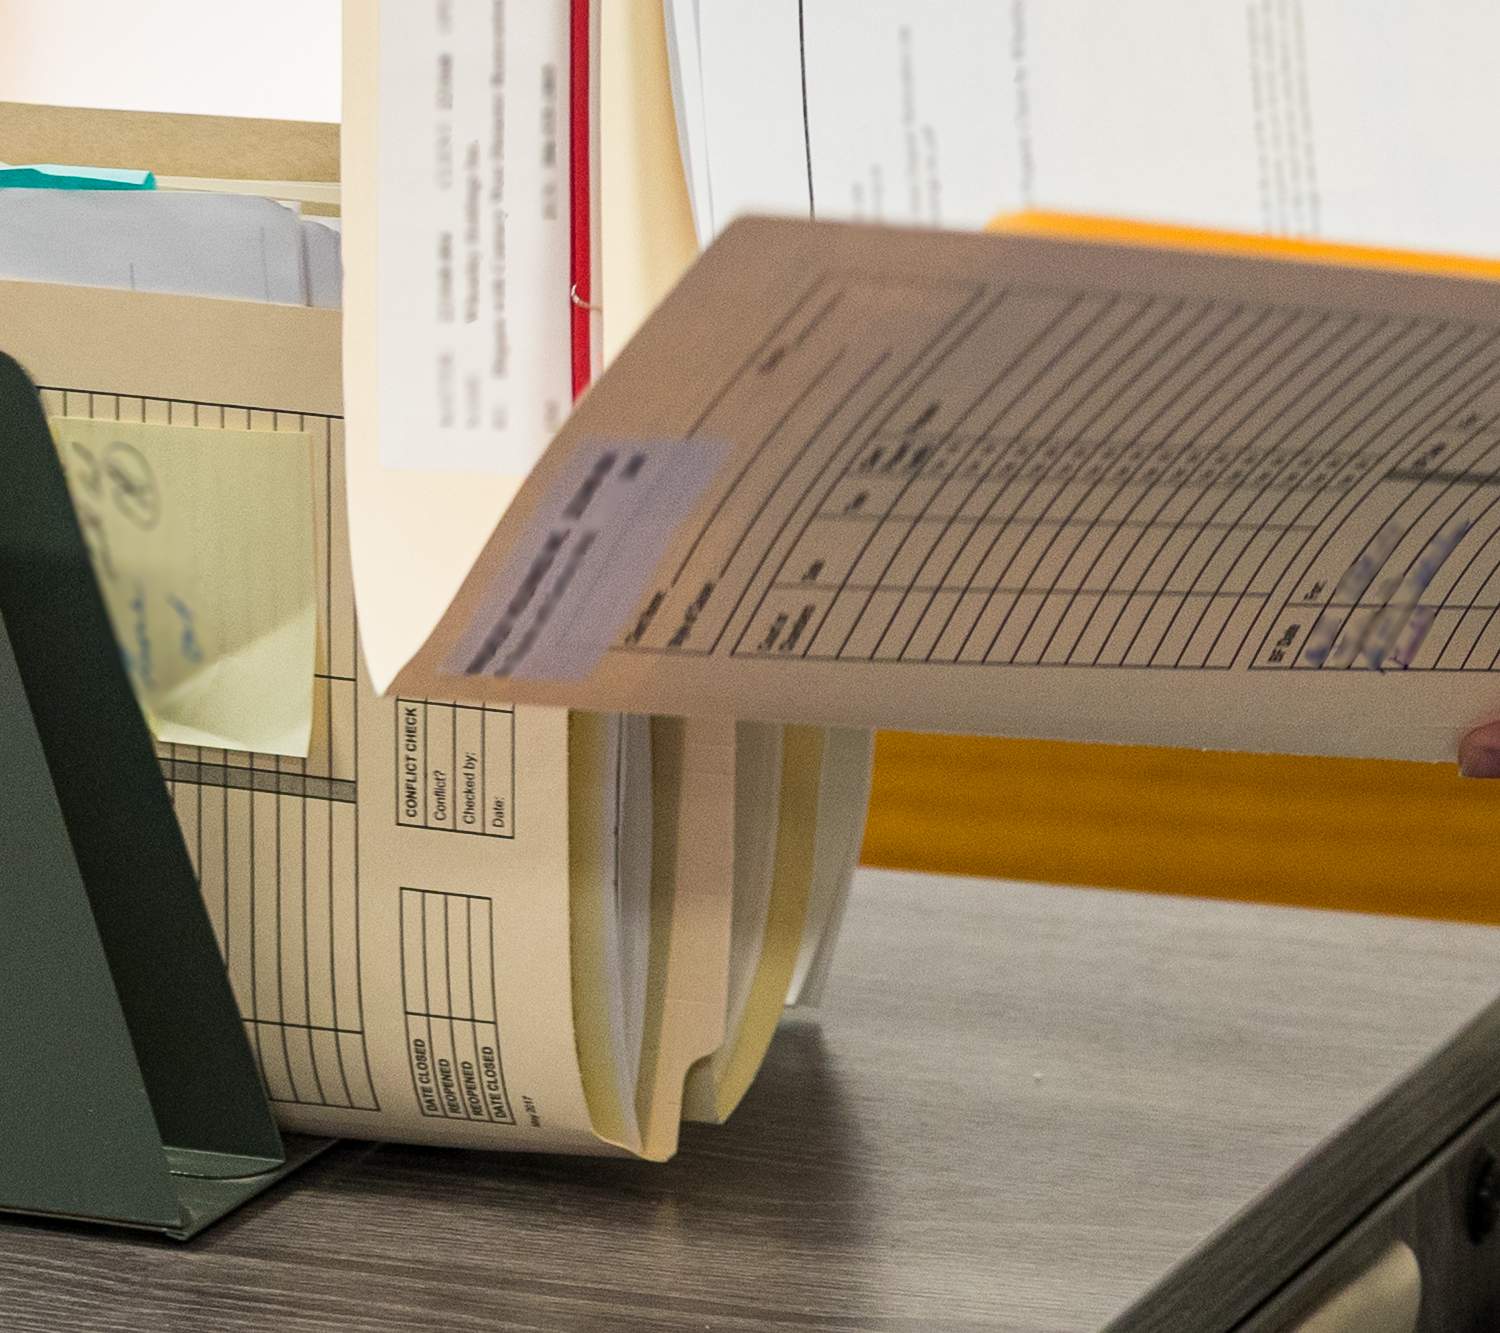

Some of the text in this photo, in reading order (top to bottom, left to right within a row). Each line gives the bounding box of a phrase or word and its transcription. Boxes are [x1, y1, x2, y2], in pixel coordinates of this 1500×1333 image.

[405, 707, 418, 818] CONFLICT CHECK
[463, 751, 478, 825] Checked by:
[433, 770, 447, 821] Conflict?
[492, 796, 506, 828] Date:
[413, 1038, 438, 1113] DATE CLOSED
[438, 1058, 461, 1114] REOPENED
[461, 1061, 483, 1116] REOPENED
[482, 1046, 507, 1118] DATE CLOSED
